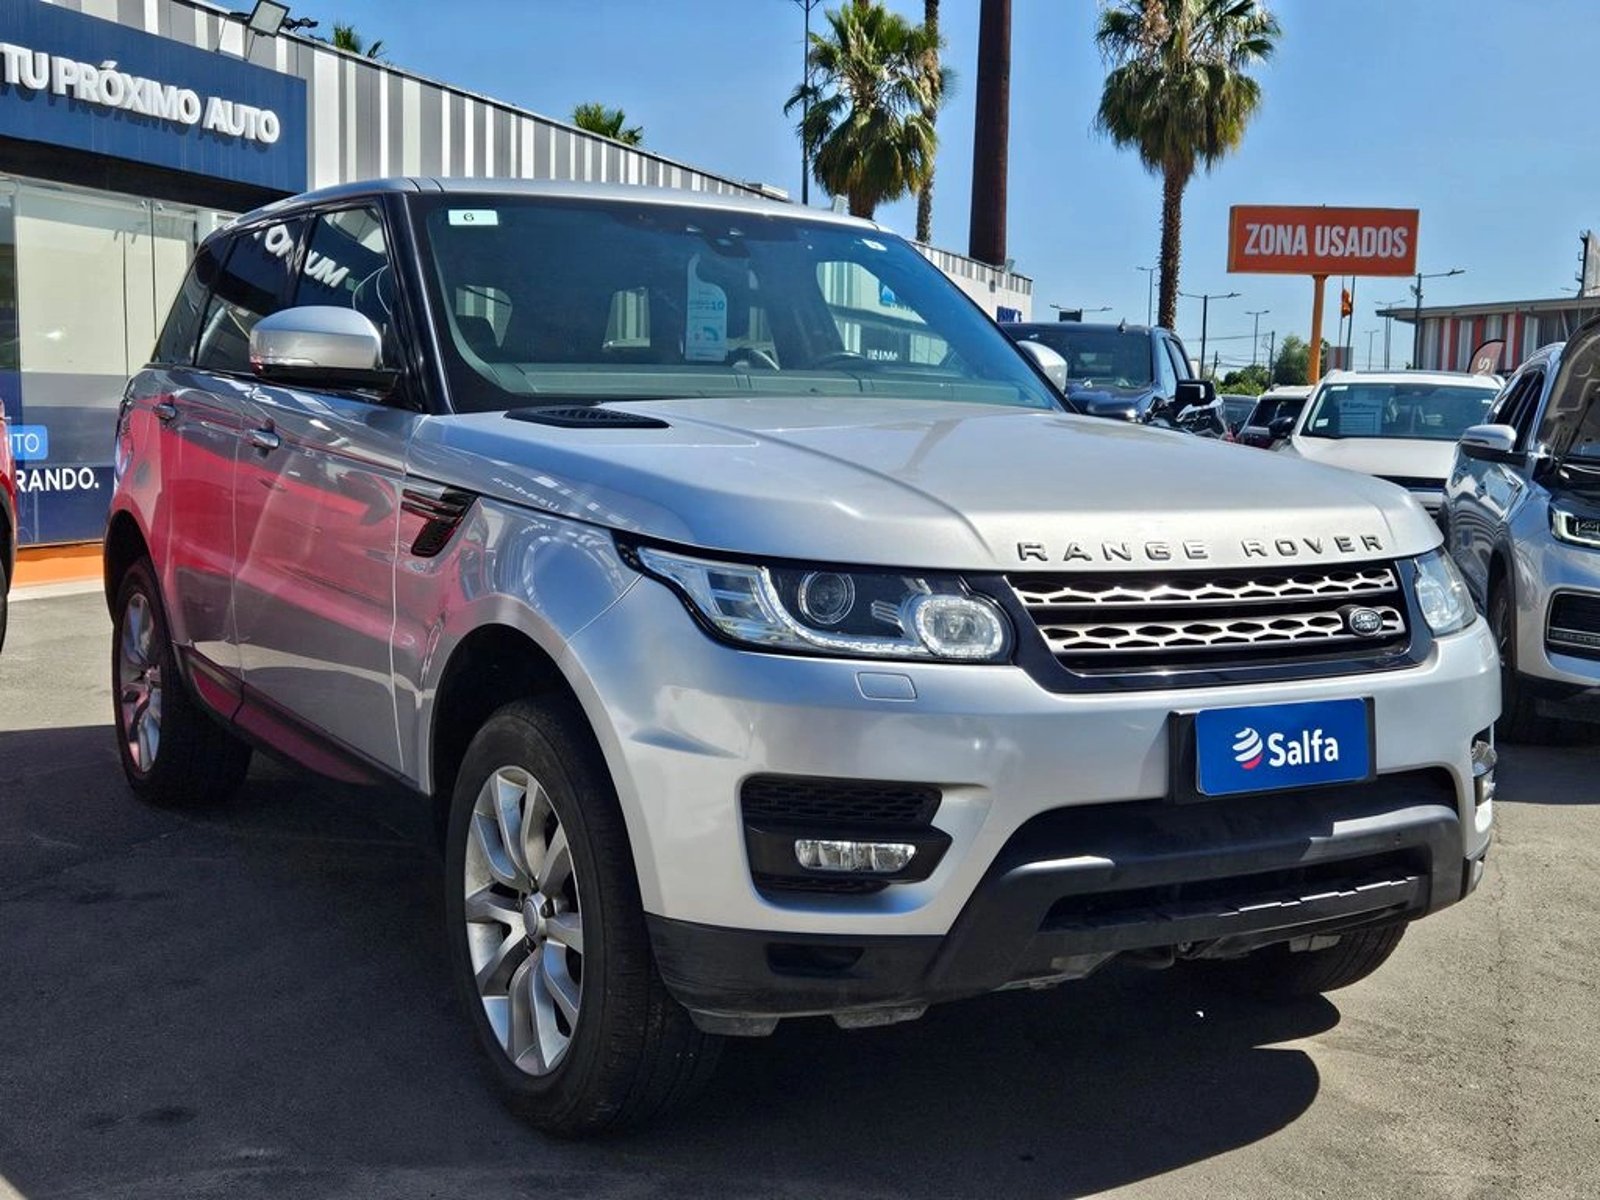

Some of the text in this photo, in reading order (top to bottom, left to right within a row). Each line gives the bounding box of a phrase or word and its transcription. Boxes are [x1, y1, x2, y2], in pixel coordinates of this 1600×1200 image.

[0, 42, 280, 143] TU PRÓXIMO AUTO
[1244, 223, 1408, 258] ZONA USADOS
[1016, 534, 1384, 562] RANGE ROVER
[1267, 729, 1339, 767] Salfa
